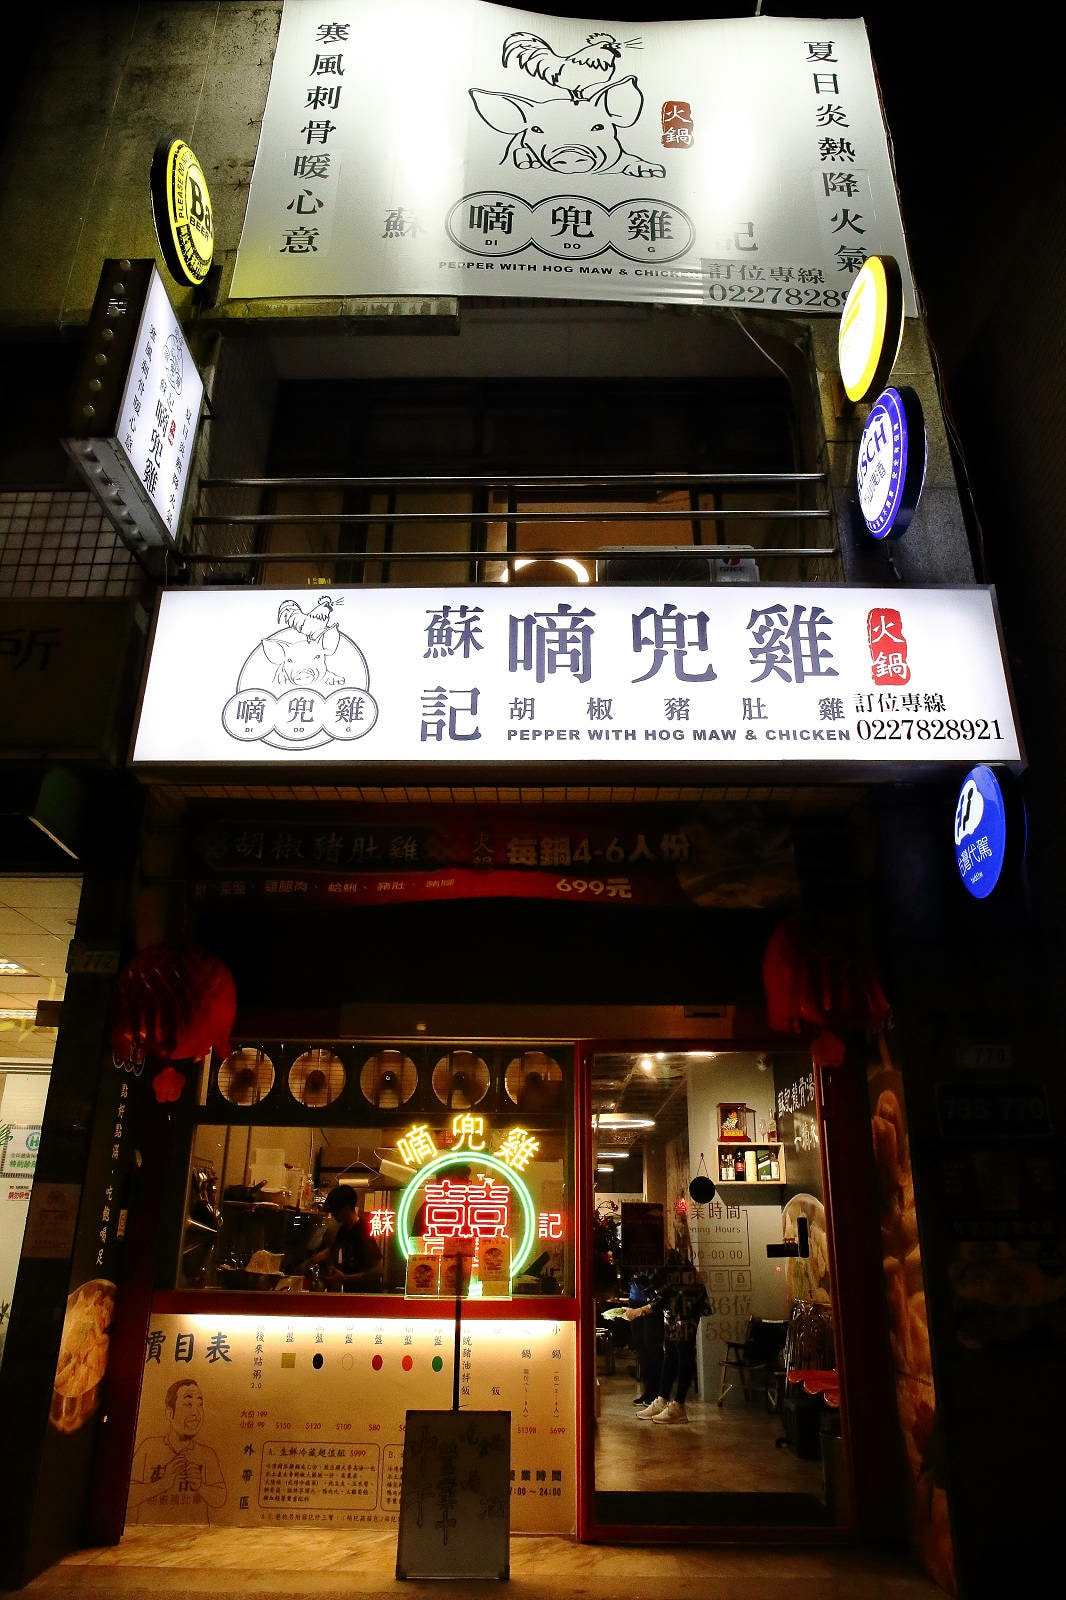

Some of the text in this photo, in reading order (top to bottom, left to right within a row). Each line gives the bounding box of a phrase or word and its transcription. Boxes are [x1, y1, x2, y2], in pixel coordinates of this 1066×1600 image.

[279, 21, 351, 254] 寒風刺骨暖心意
[665, 104, 693, 145] 火鍋
[804, 39, 868, 273] 夏日炎熱降火氣
[190, 216, 209, 241] BEER
[468, 203, 675, 242] 嘀兜雞
[438, 261, 495, 271] PEPPER
[499, 263, 537, 273] WITH
[542, 265, 573, 274] HOG
[579, 266, 619, 276] MAW
[709, 262, 825, 284] 訂位專線
[508, 602, 839, 684] 嘀兜雞
[870, 611, 911, 679] 火鍋
[420, 604, 485, 742] 蘇記
[236, 696, 366, 724] 嘀兜雞
[509, 696, 846, 721] 胡椒豬肚雞
[854, 692, 948, 714] 訂位專線
[507, 729, 851, 741] PEPPER WITH HOG MAW & CHICKEN
[856, 719, 1006, 742] 0227828921
[507, 833, 692, 867] 每鍋4-6人份
[556, 877, 633, 899] 699元
[396, 1112, 542, 1173] 嘀兜雞
[369, 1208, 396, 1238] 蘇
[538, 1211, 564, 1239] 記
